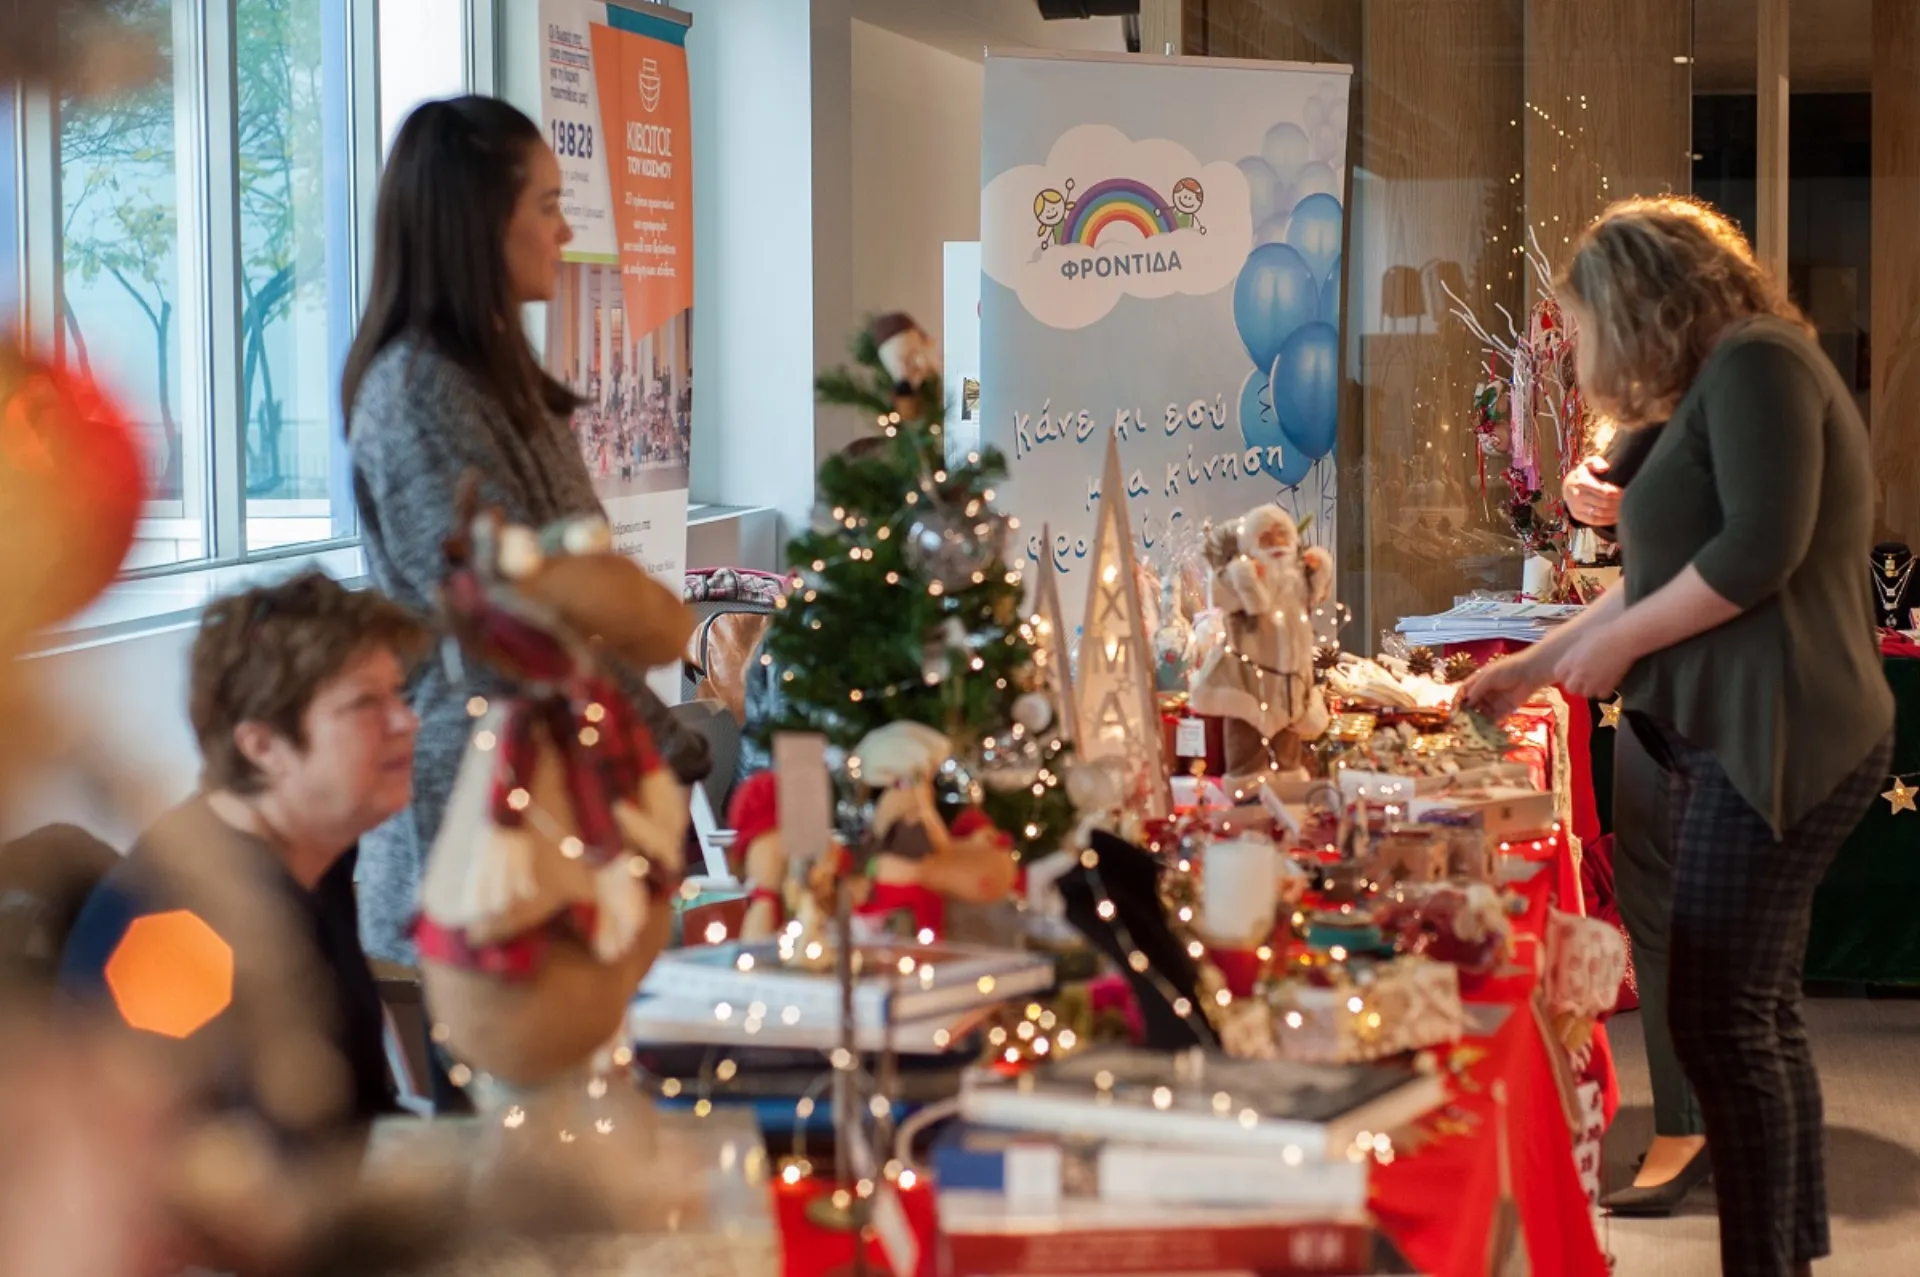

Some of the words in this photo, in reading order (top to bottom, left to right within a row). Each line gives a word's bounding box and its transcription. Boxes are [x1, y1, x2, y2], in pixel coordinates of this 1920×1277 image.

[552, 118, 593, 159] 19828
[1061, 250, 1182, 280] ΦΡΟΝΤΙΔΑ
[1114, 406, 1148, 441] κι
[1165, 392, 1228, 437] εσύ
[1086, 468, 1149, 512] μα
[1164, 443, 1284, 497] κίνηση
